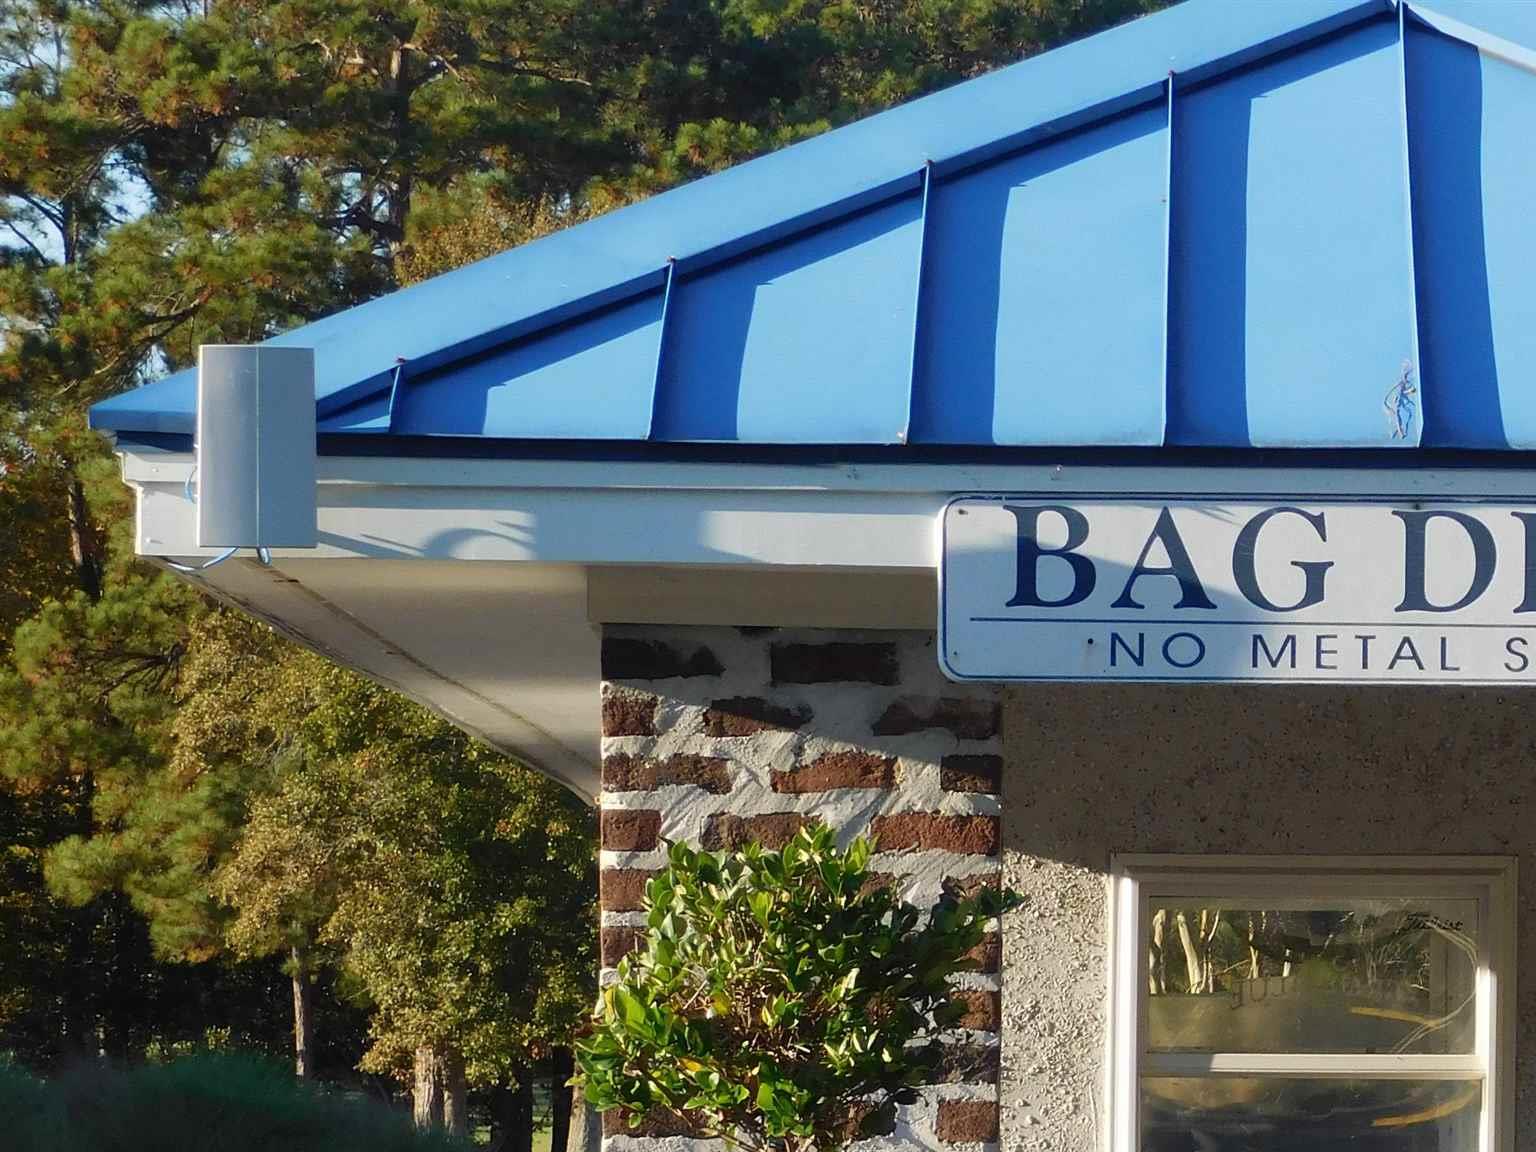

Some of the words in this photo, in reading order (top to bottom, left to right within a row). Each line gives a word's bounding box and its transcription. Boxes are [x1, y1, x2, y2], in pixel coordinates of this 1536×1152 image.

[1002, 504, 1336, 613] BAG
[1109, 631, 1206, 669] NO
[1251, 632, 1461, 672] METAL
